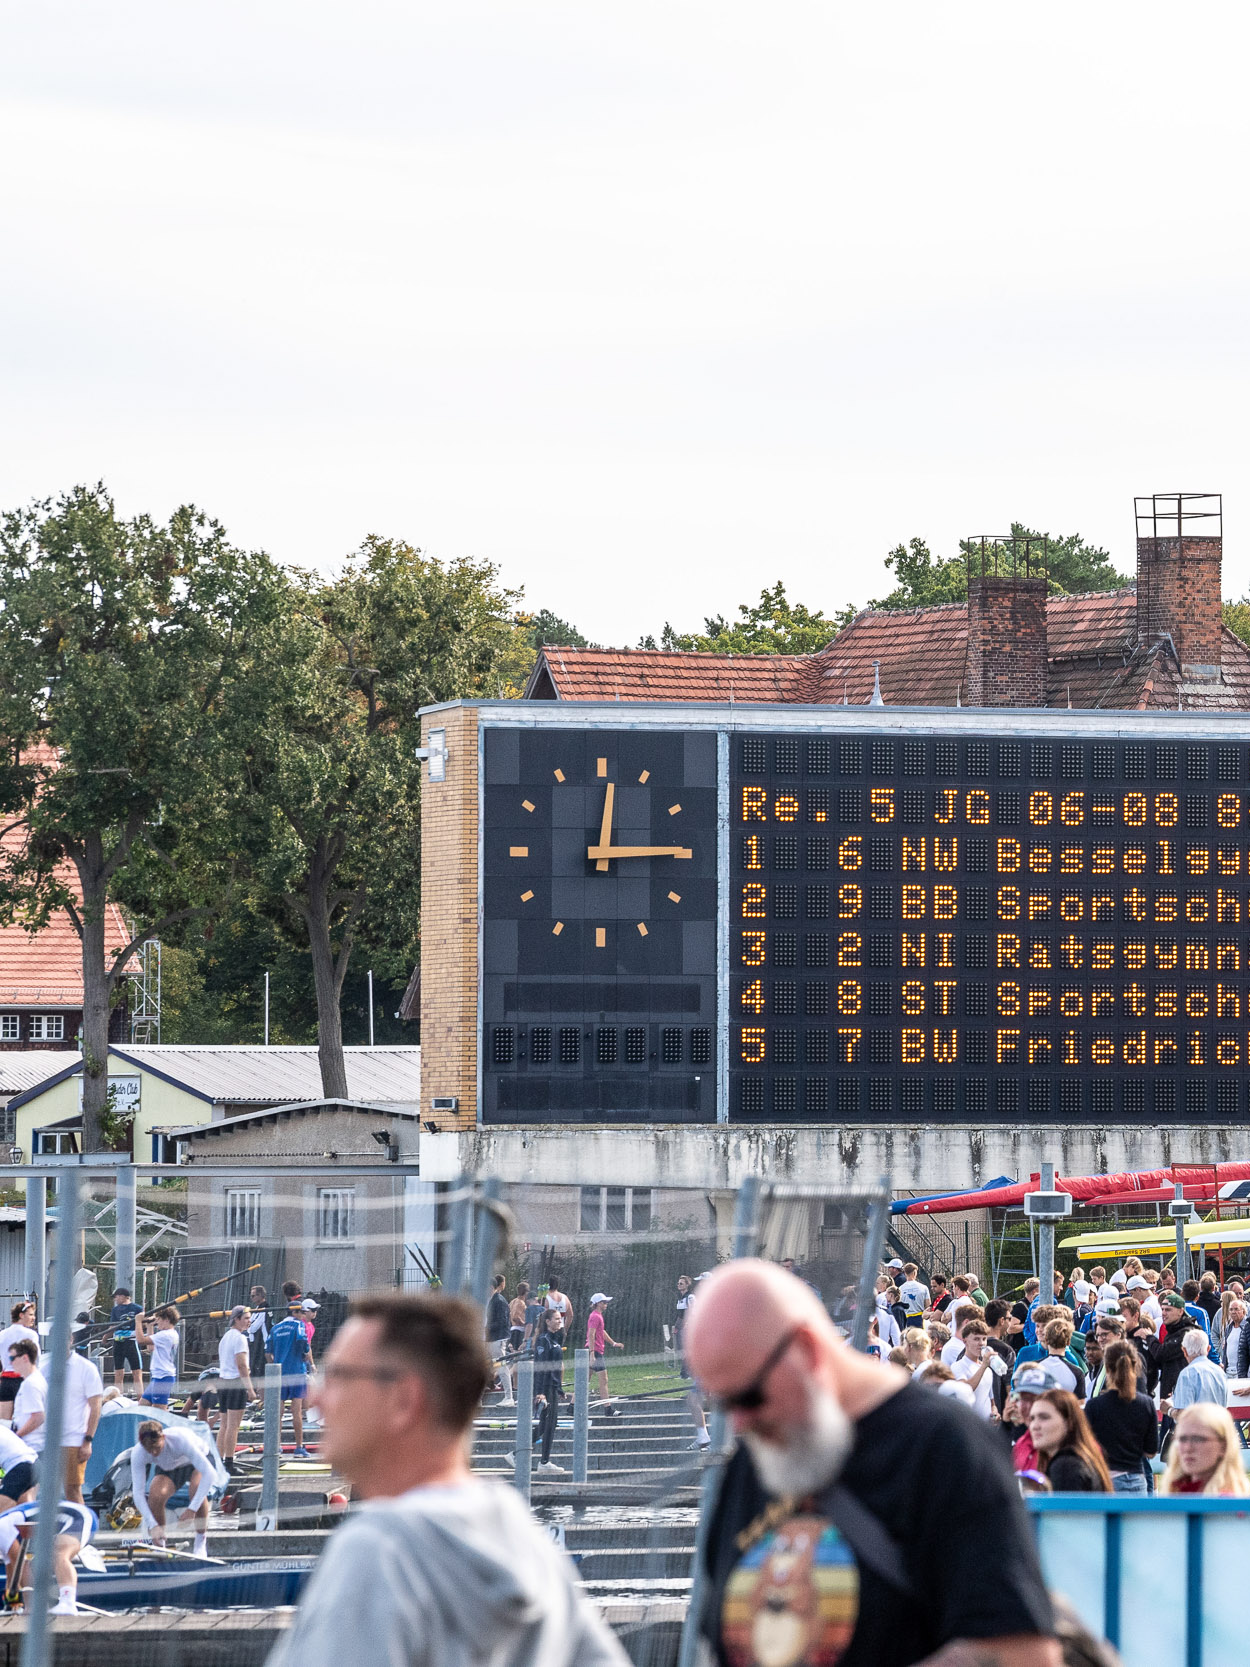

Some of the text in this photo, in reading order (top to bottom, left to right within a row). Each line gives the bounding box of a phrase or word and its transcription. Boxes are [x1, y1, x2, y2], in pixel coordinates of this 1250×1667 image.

[742, 786, 827, 822] Re.
[870, 788, 895, 823] 5
[934, 789, 990, 825] JG
[1029, 790, 1178, 827] 06-08
[746, 834, 762, 870] 1
[838, 835, 863, 871] 6
[902, 836, 958, 872] NW
[742, 882, 767, 918] 2
[838, 883, 863, 919] 9
[901, 884, 958, 920] BB
[741, 931, 766, 966] 3
[837, 932, 862, 967] 2
[901, 932, 953, 968] NI
[741, 979, 766, 1014] 4
[837, 980, 862, 1015] 8
[901, 980, 958, 1015] ST
[741, 1027, 766, 1063] 5
[837, 1028, 862, 1063] 7
[901, 1028, 958, 1064] BW
[262, 1515, 270, 1531] 2
